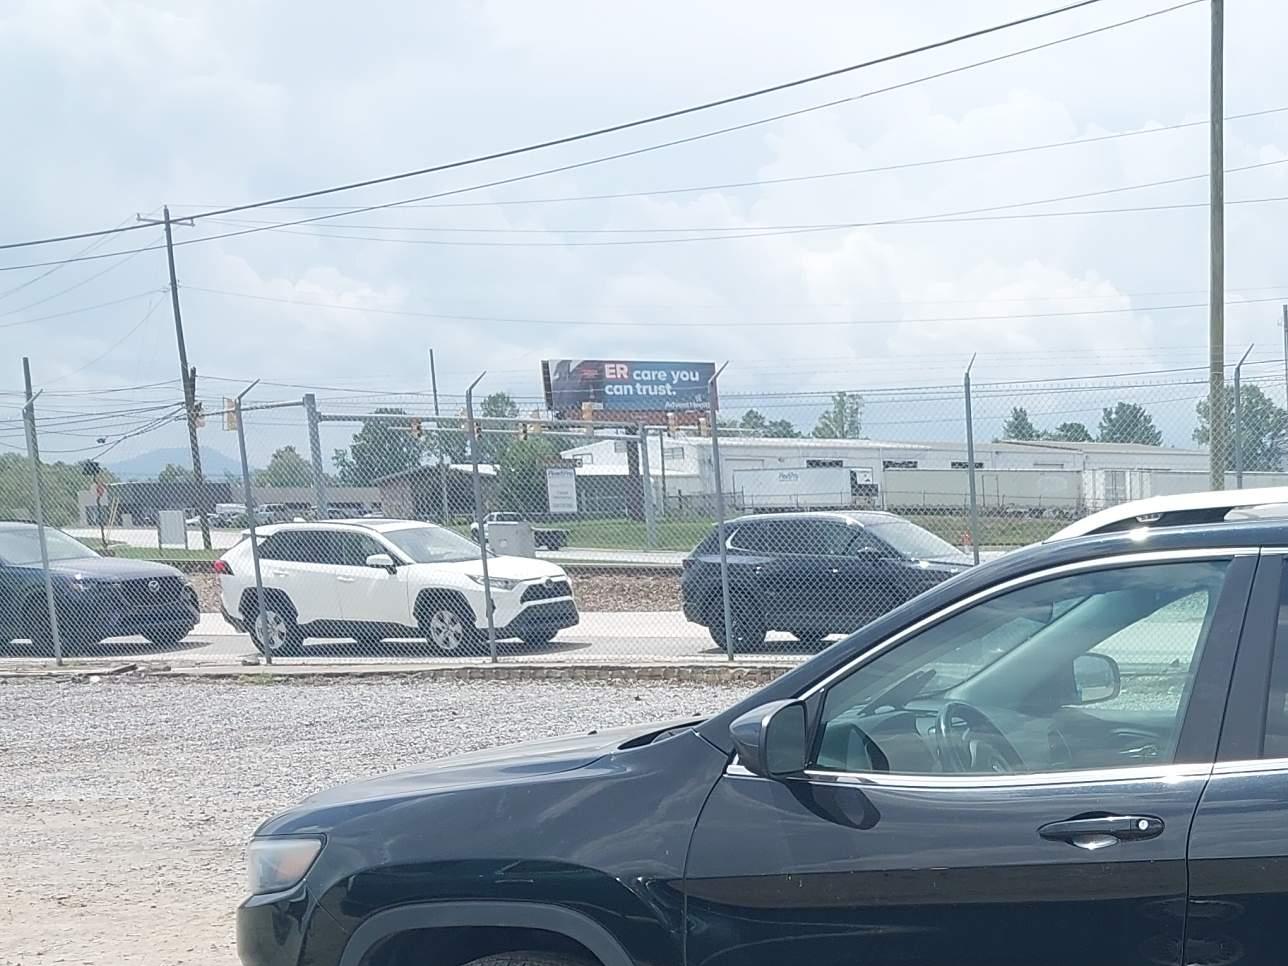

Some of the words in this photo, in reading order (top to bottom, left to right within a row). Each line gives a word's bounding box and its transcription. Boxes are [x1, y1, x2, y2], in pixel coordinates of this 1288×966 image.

[604, 363, 629, 379] ER
[633, 369, 667, 381] care
[672, 370, 699, 384] you
[604, 383, 633, 396] can
[636, 383, 677, 396] trust.
